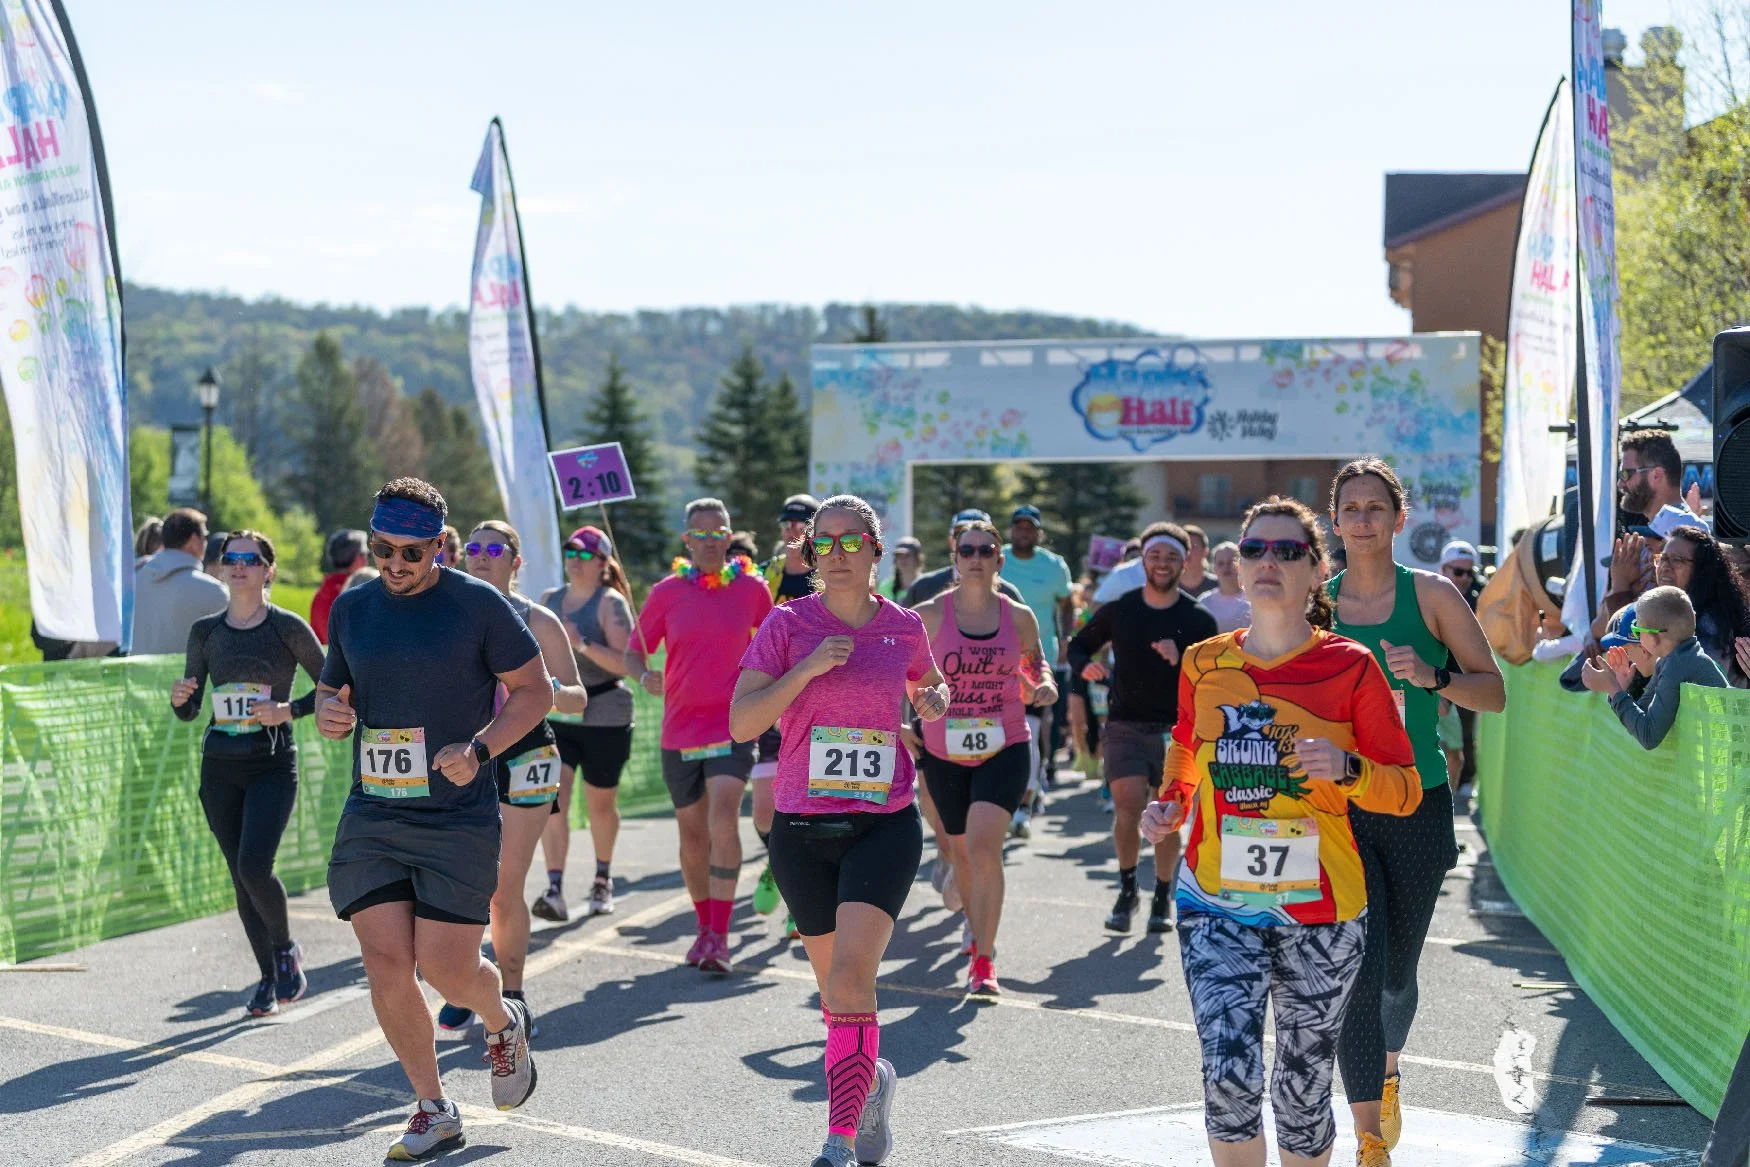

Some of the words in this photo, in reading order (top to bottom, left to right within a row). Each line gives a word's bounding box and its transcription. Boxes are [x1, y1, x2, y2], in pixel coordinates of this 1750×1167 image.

[568, 471, 621, 499] 2:10
[943, 651, 994, 682] Quit
[971, 680, 1005, 690] MIGHT
[224, 697, 257, 716] 115
[962, 732, 988, 751] 48
[1216, 739, 1278, 765] SKUNK
[366, 748, 412, 774] 176
[526, 763, 551, 784] 47
[824, 748, 881, 778] 213
[1209, 764, 1288, 789] CABBAGE
[854, 791, 873, 799] 213
[1225, 785, 1274, 802] classic
[1247, 844, 1290, 877] 37
